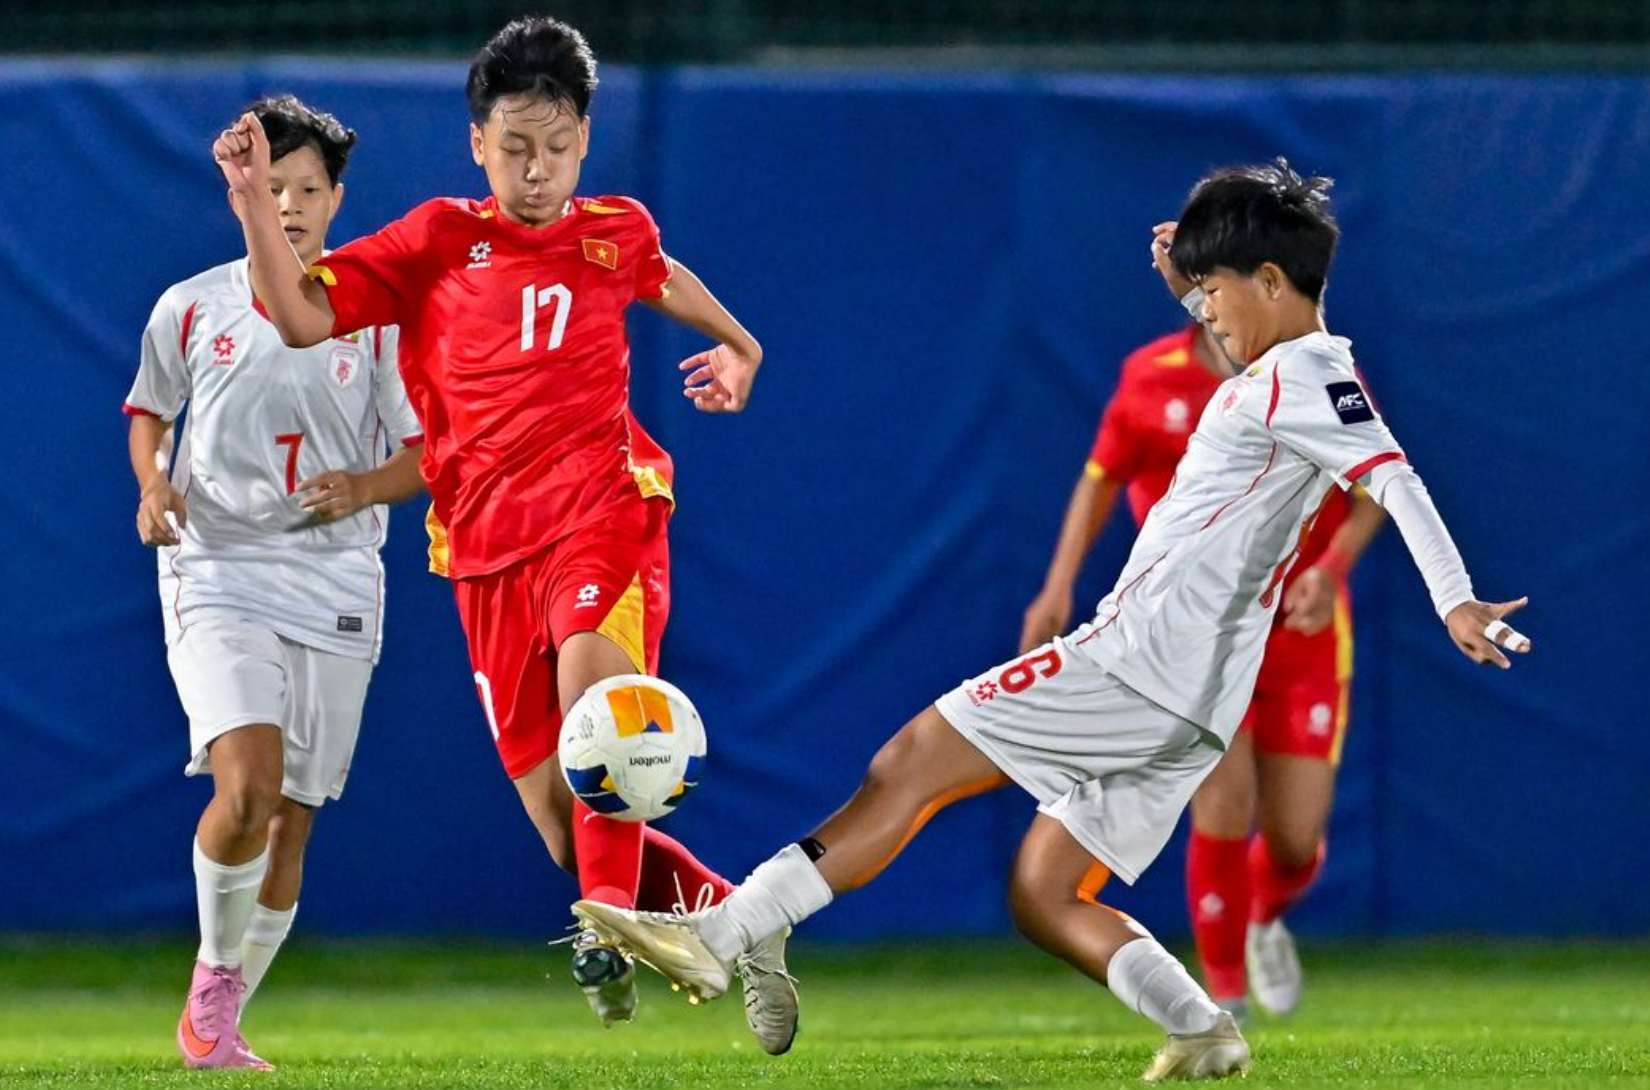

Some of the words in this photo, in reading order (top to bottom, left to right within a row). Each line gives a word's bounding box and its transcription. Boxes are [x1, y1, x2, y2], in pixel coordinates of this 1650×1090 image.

[520, 282, 573, 352] 17
[1337, 393, 1364, 409] AFC
[275, 432, 305, 497] 7
[998, 648, 1063, 694] 6
[629, 755, 671, 767] molten
